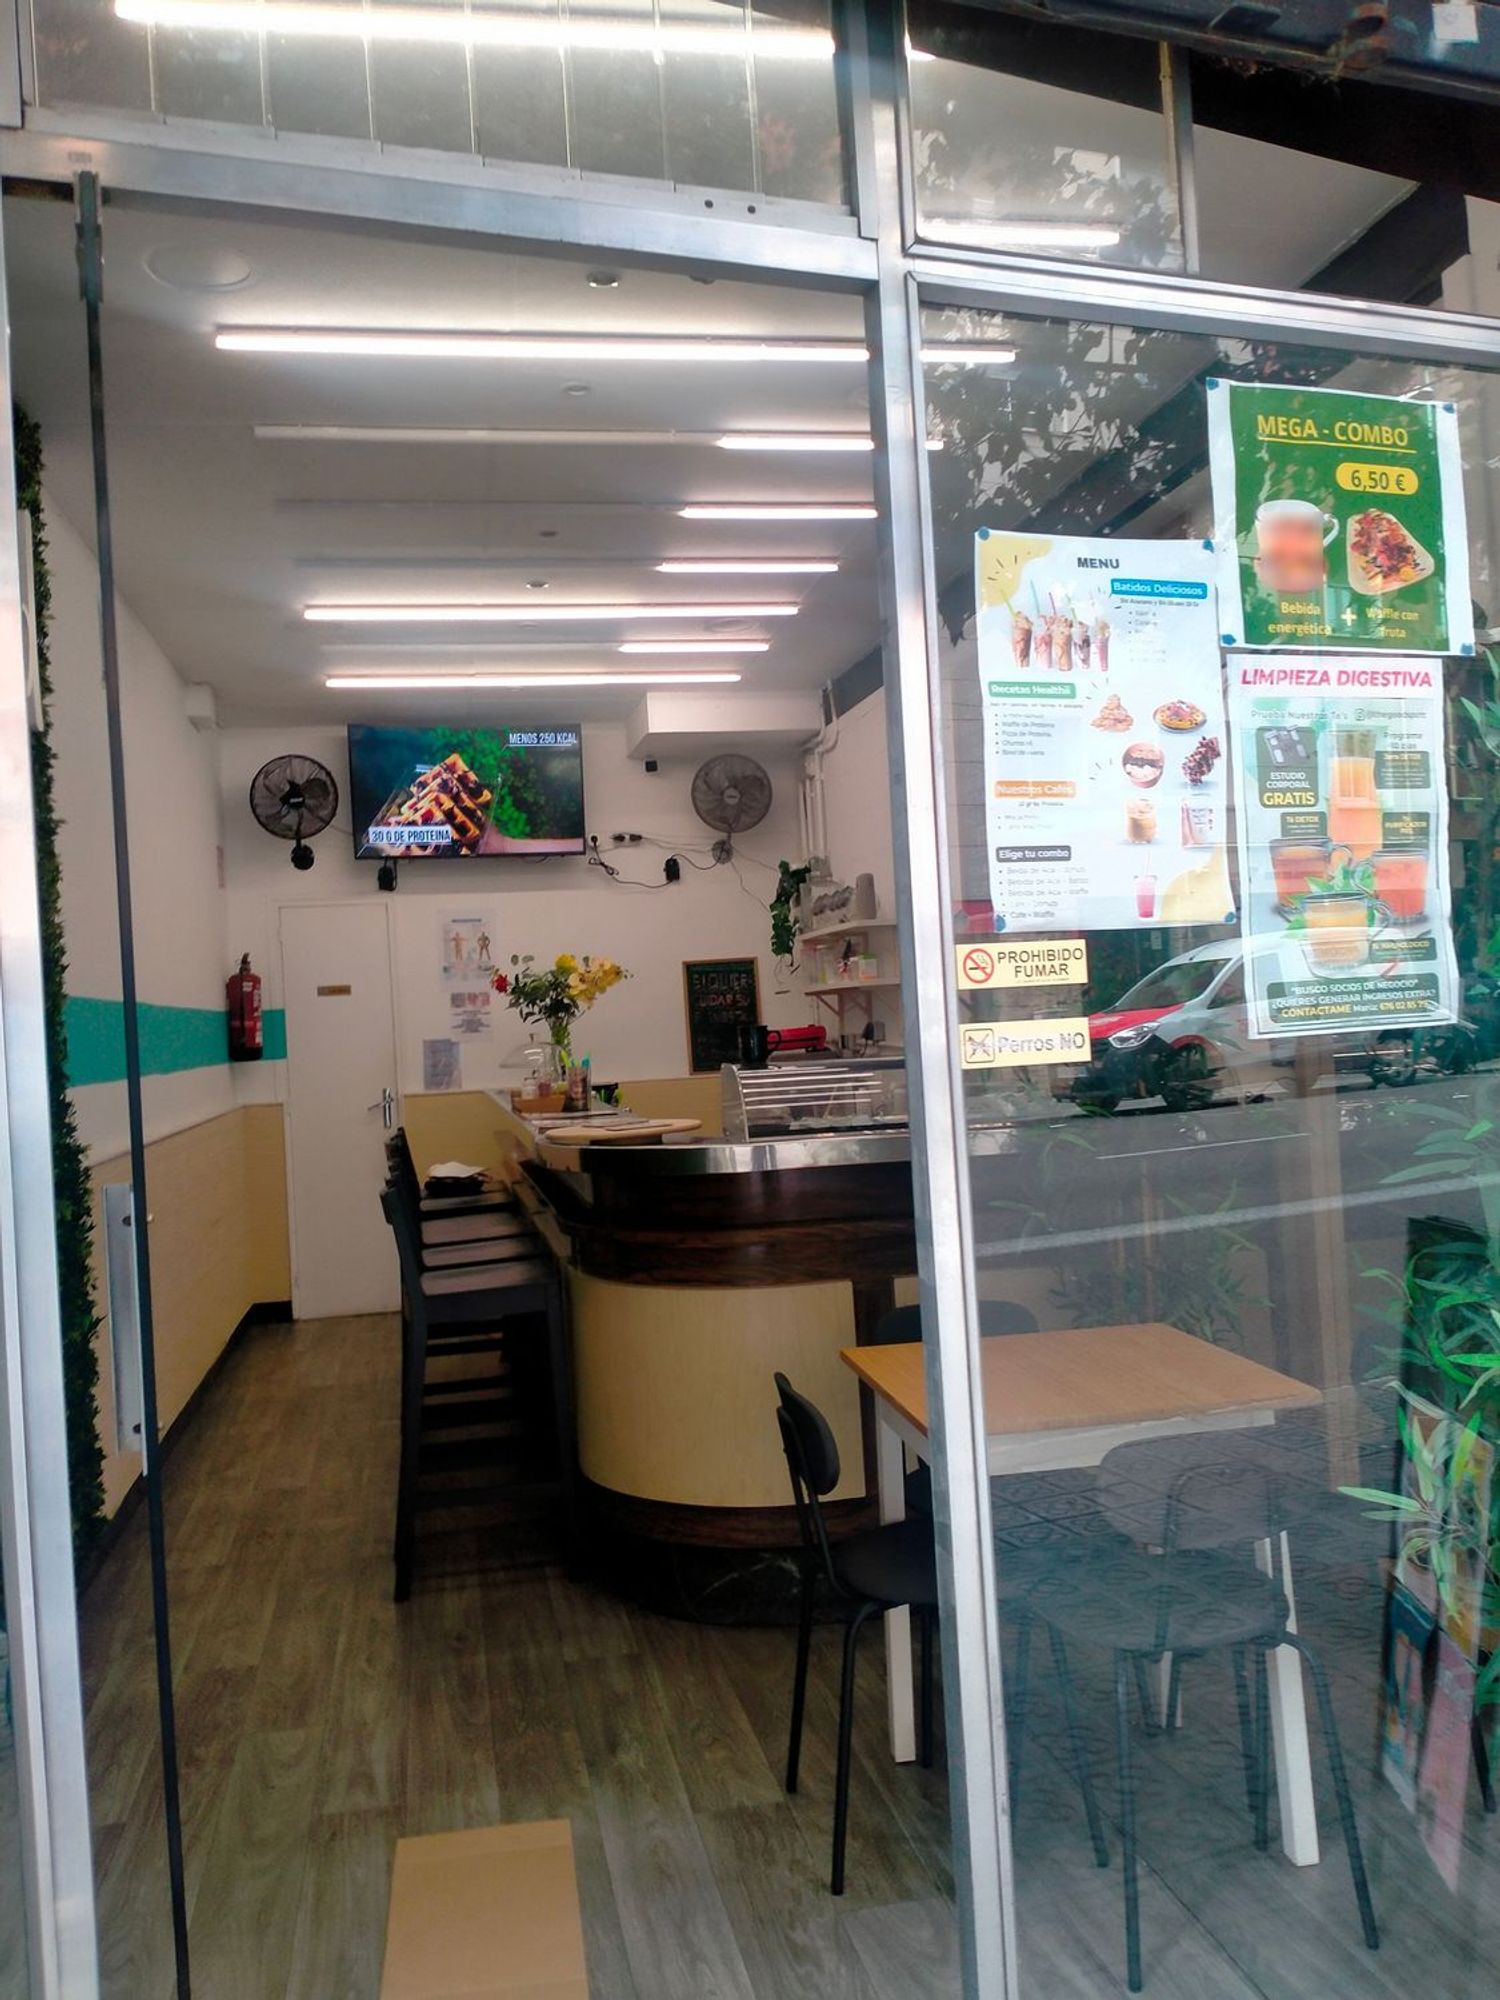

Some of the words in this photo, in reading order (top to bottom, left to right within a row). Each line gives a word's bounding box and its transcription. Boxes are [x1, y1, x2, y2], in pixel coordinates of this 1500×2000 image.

[1257, 415, 1318, 438] MEGA
[1334, 421, 1408, 446] COMBO
[1351, 469, 1389, 491] 6,50
[1395, 473, 1406, 491] €
[1077, 556, 1120, 570] MENU
[1113, 582, 1152, 593] Batidos
[1153, 584, 1203, 596] Deliciosos
[1281, 602, 1321, 615] Bebida
[1241, 668, 1331, 687] LIMPIEZA
[1336, 670, 1433, 688] DIGESTIVA
[991, 684, 1031, 694] Recetas
[509, 733, 538, 744] MENOS
[539, 733, 556, 744] 250
[556, 733, 578, 744] KCAL
[1271, 772, 1306, 781] ESTUDIO
[1266, 780, 1311, 789] CORPORAL
[1263, 792, 1315, 806] GRATIS
[394, 830, 406, 842] DE
[407, 828, 450, 842] PROTEINA
[999, 849, 1023, 860] Elige
[1025, 850, 1036, 858] tu
[1037, 848, 1070, 858] combo
[997, 948, 1084, 964] PROHIBIDO
[1014, 963, 1070, 978] FUMAR
[1330, 982, 1362, 992] SOCIOS
[1363, 981, 1375, 990] DE
[1318, 993, 1361, 1005] GENERAR
[1362, 991, 1403, 1001] INGRESOS
[1281, 1004, 1352, 1018] CONTACTAME
[998, 1036, 1055, 1053] Perros
[1060, 1032, 1086, 1050] NO
